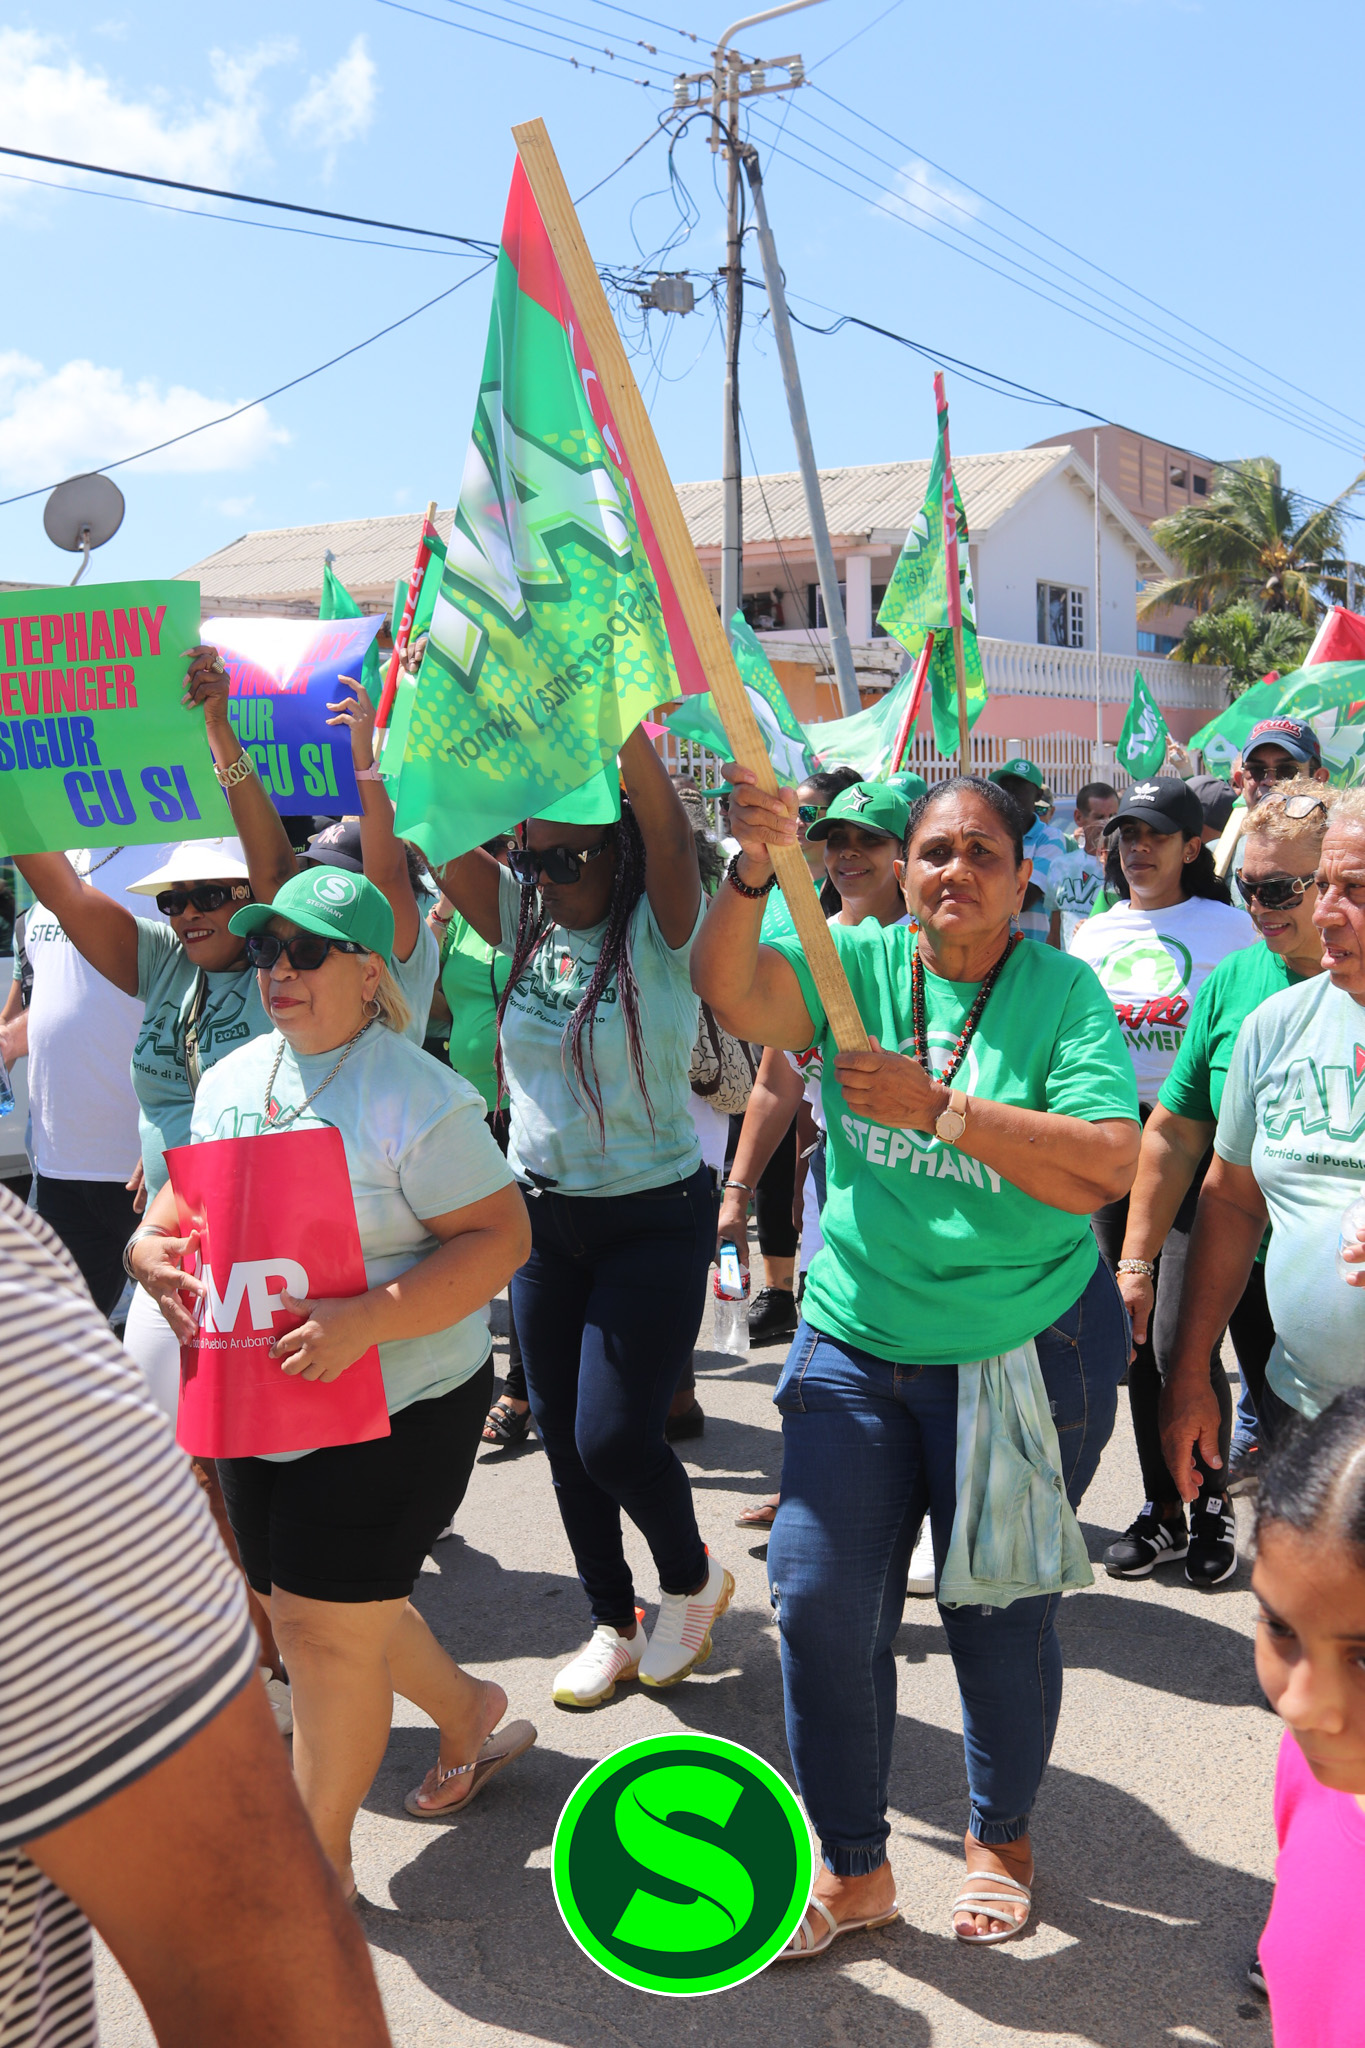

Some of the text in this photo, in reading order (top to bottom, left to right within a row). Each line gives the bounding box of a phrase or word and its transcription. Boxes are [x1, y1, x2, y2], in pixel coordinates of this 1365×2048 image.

[0, 664, 138, 717] EVINGER
[227, 698, 275, 742] GUR
[1251, 719, 1302, 738] Aruba
[0, 716, 102, 772] SIGUR
[252, 743, 339, 797] CU SI
[63, 765, 202, 827] CU SI
[1130, 793, 1156, 801] adidas
[320, 877, 349, 901] S
[305, 898, 344, 919] STEPHANY
[534, 1009, 565, 1028] Pueblo
[216, 1024, 247, 1042] 2024
[132, 1058, 159, 1076] artido
[160, 1068, 173, 1079] di
[840, 1114, 1001, 1194] STEPHANY
[1263, 1145, 1365, 1170] Partido di Puebl
[206, 1337, 228, 1350] Pueblo
[230, 1335, 276, 1349] Arubano
